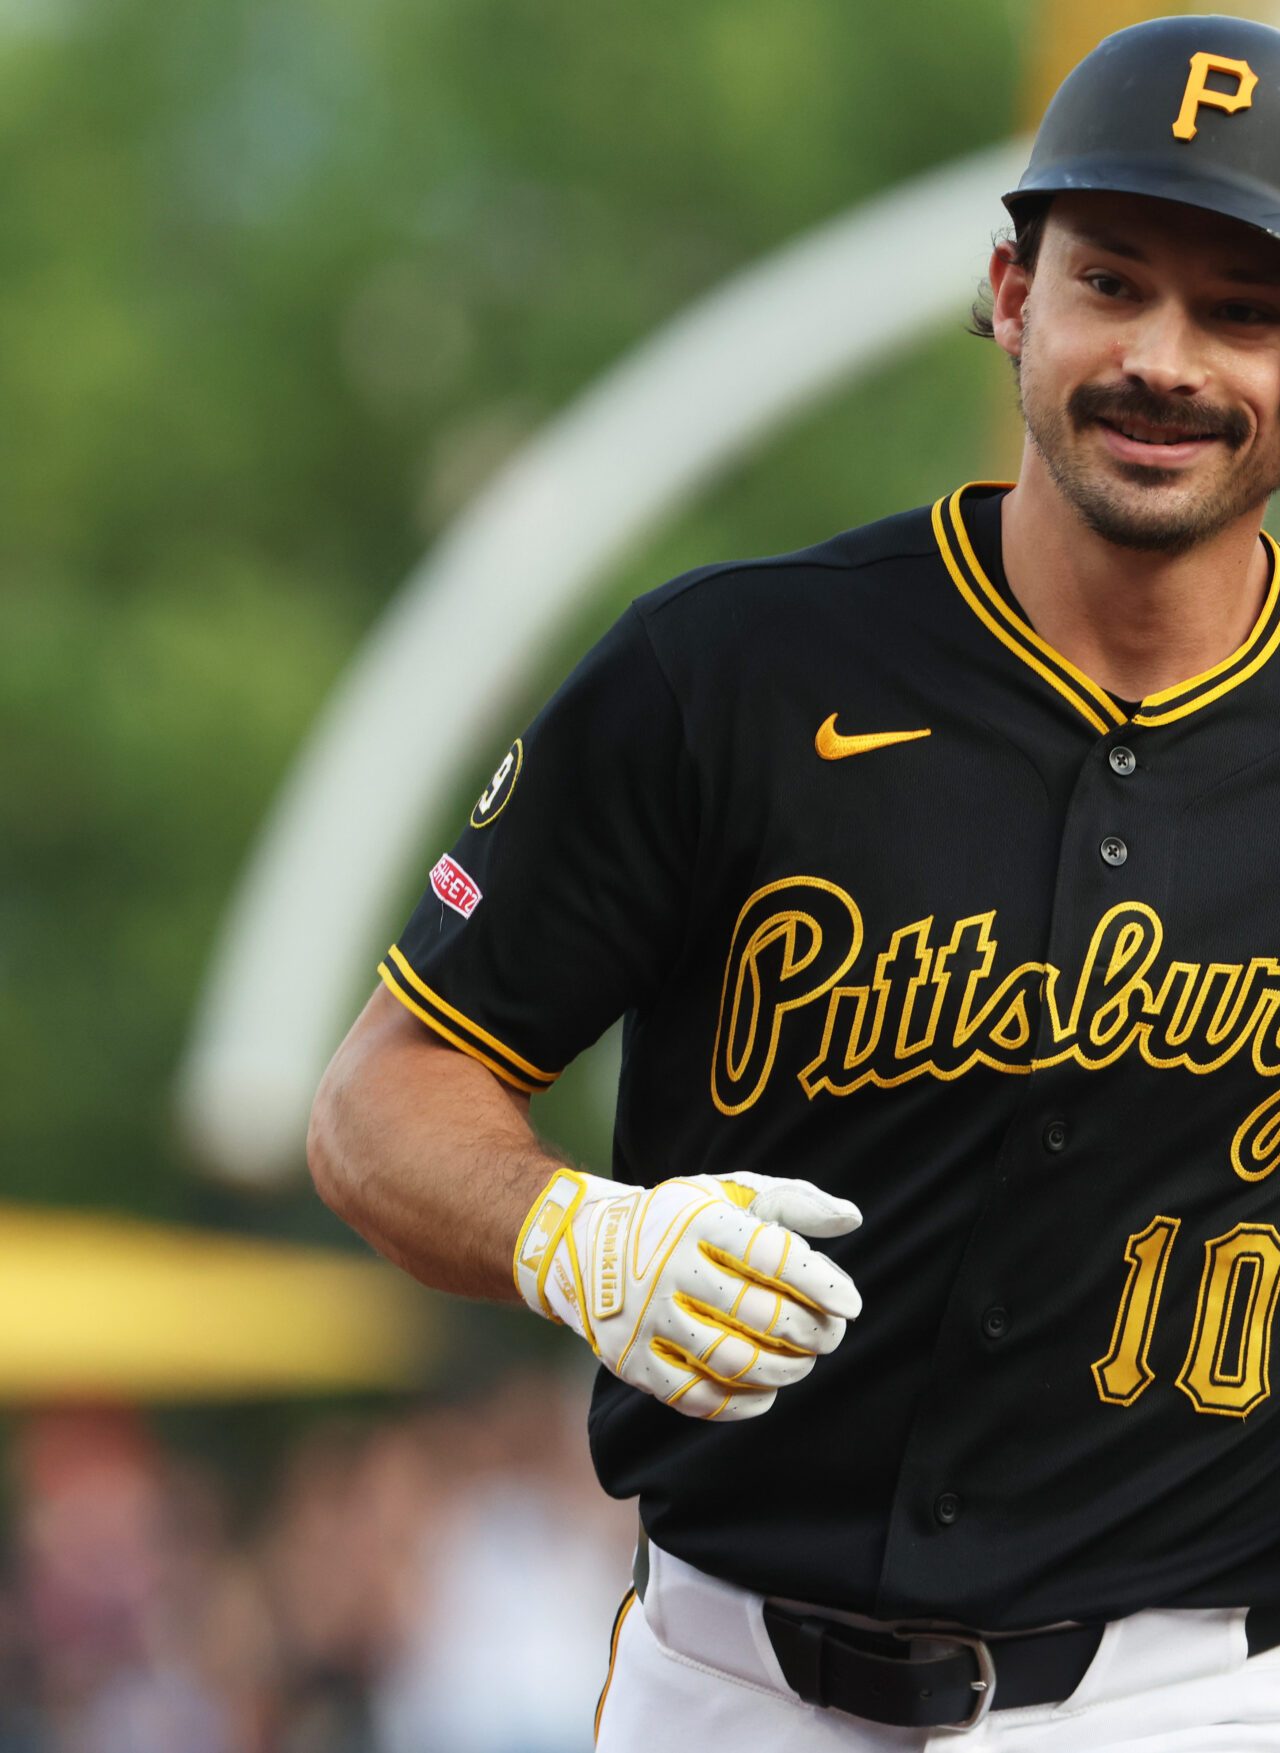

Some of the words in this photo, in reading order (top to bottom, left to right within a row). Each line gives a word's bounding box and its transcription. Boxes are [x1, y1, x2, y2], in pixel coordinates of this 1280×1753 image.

[1172, 52, 1259, 141] P
[479, 752, 514, 815] 9
[433, 859, 478, 912] SHEETZ
[601, 1206, 630, 1307] Franklin
